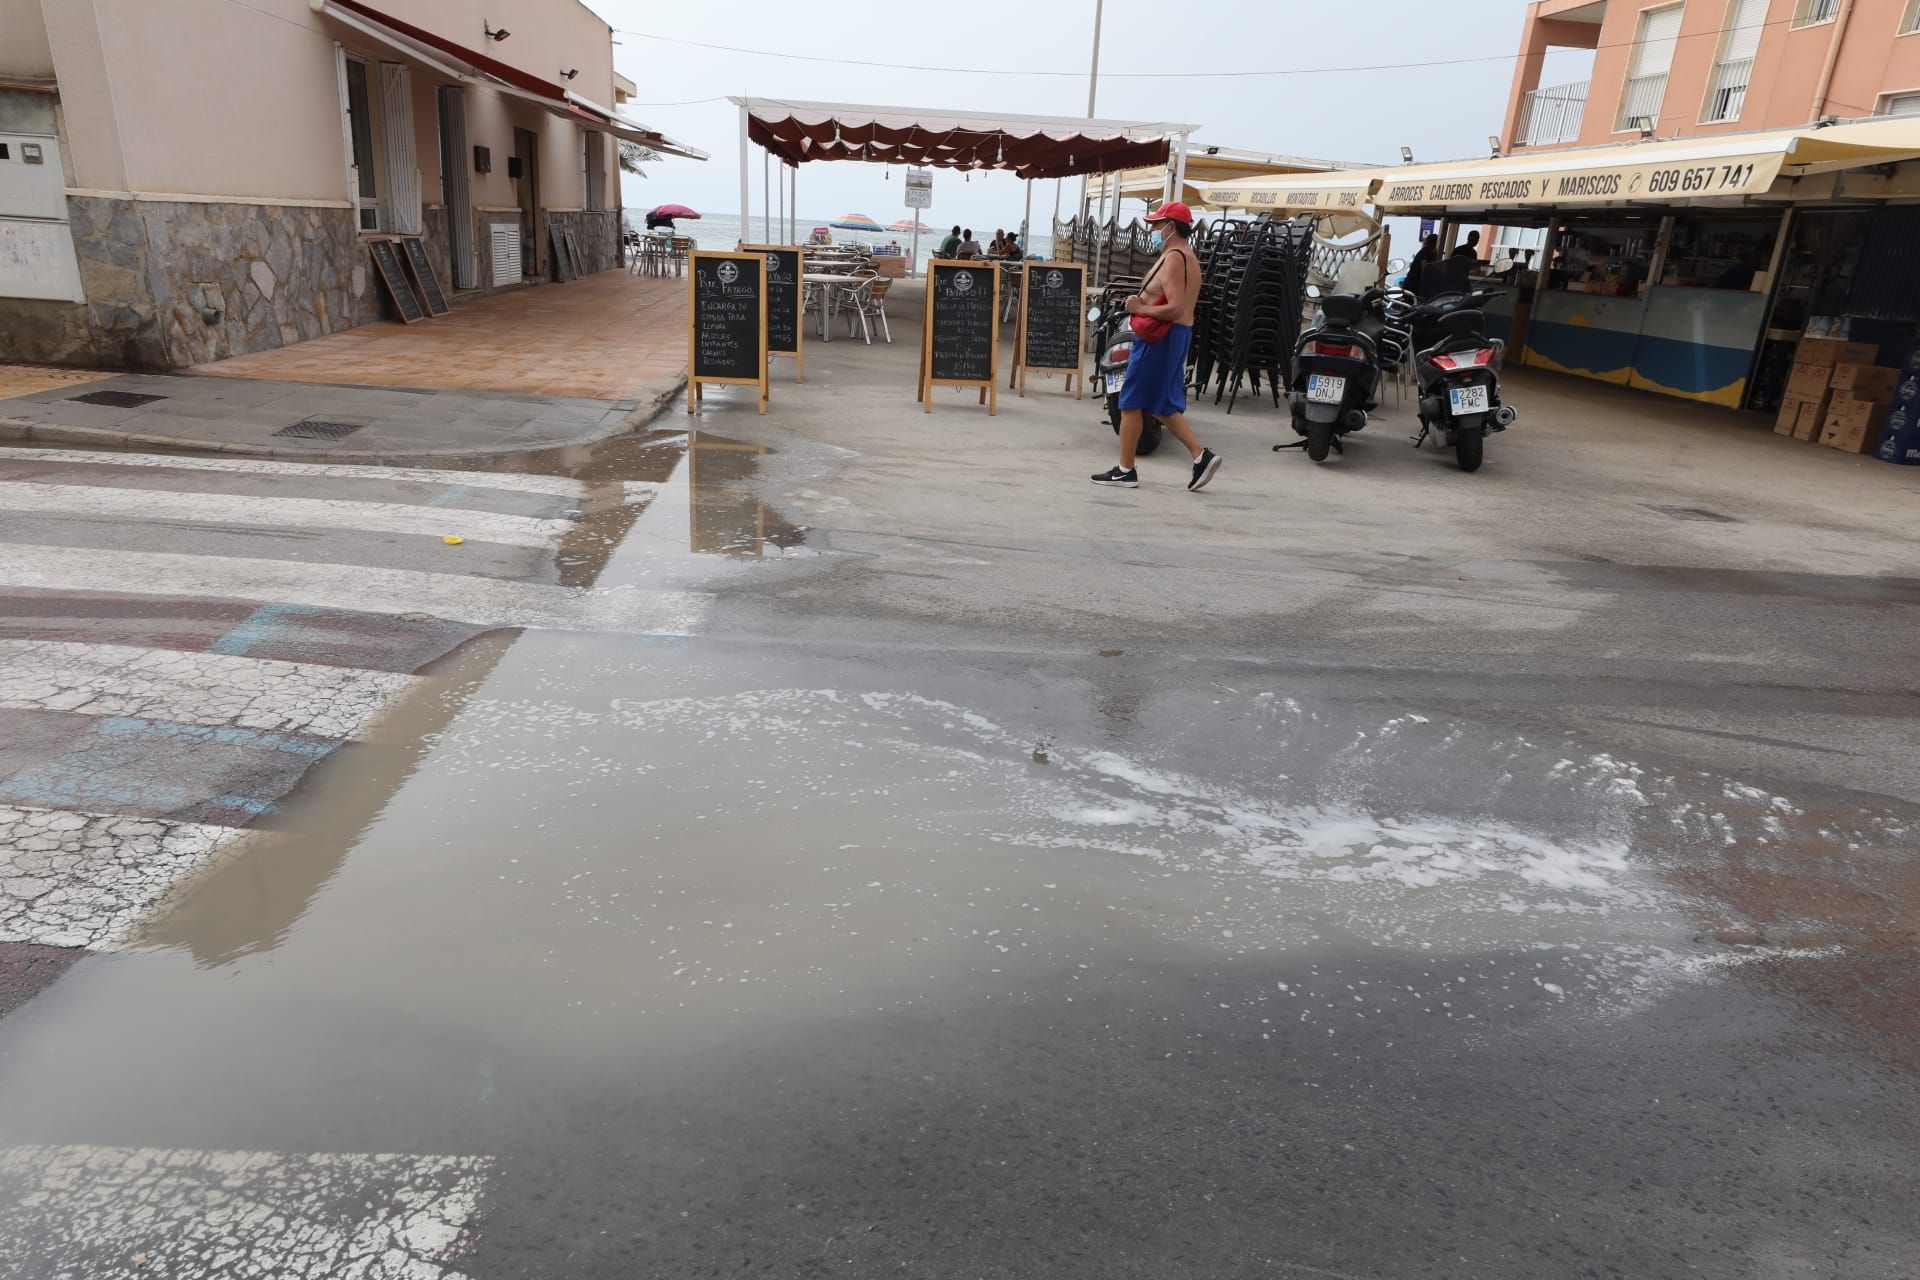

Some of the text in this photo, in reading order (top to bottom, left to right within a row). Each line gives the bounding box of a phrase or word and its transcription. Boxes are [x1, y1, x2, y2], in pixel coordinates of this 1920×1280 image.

[1388, 163, 1754, 201] ARROCES CALDEROS PESCADOS Y MARISCOS 609 657 741
[1250, 191, 1278, 204] BOCADILLOS
[1286, 191, 1319, 205] MONTADITOS
[1325, 192, 1332, 205] Y
[1338, 192, 1358, 207] TAPAS
[1317, 377, 1342, 389] 5919
[1315, 388, 1335, 399] DNJ
[1458, 387, 1484, 399] 2282
[1460, 397, 1480, 409] FMC
